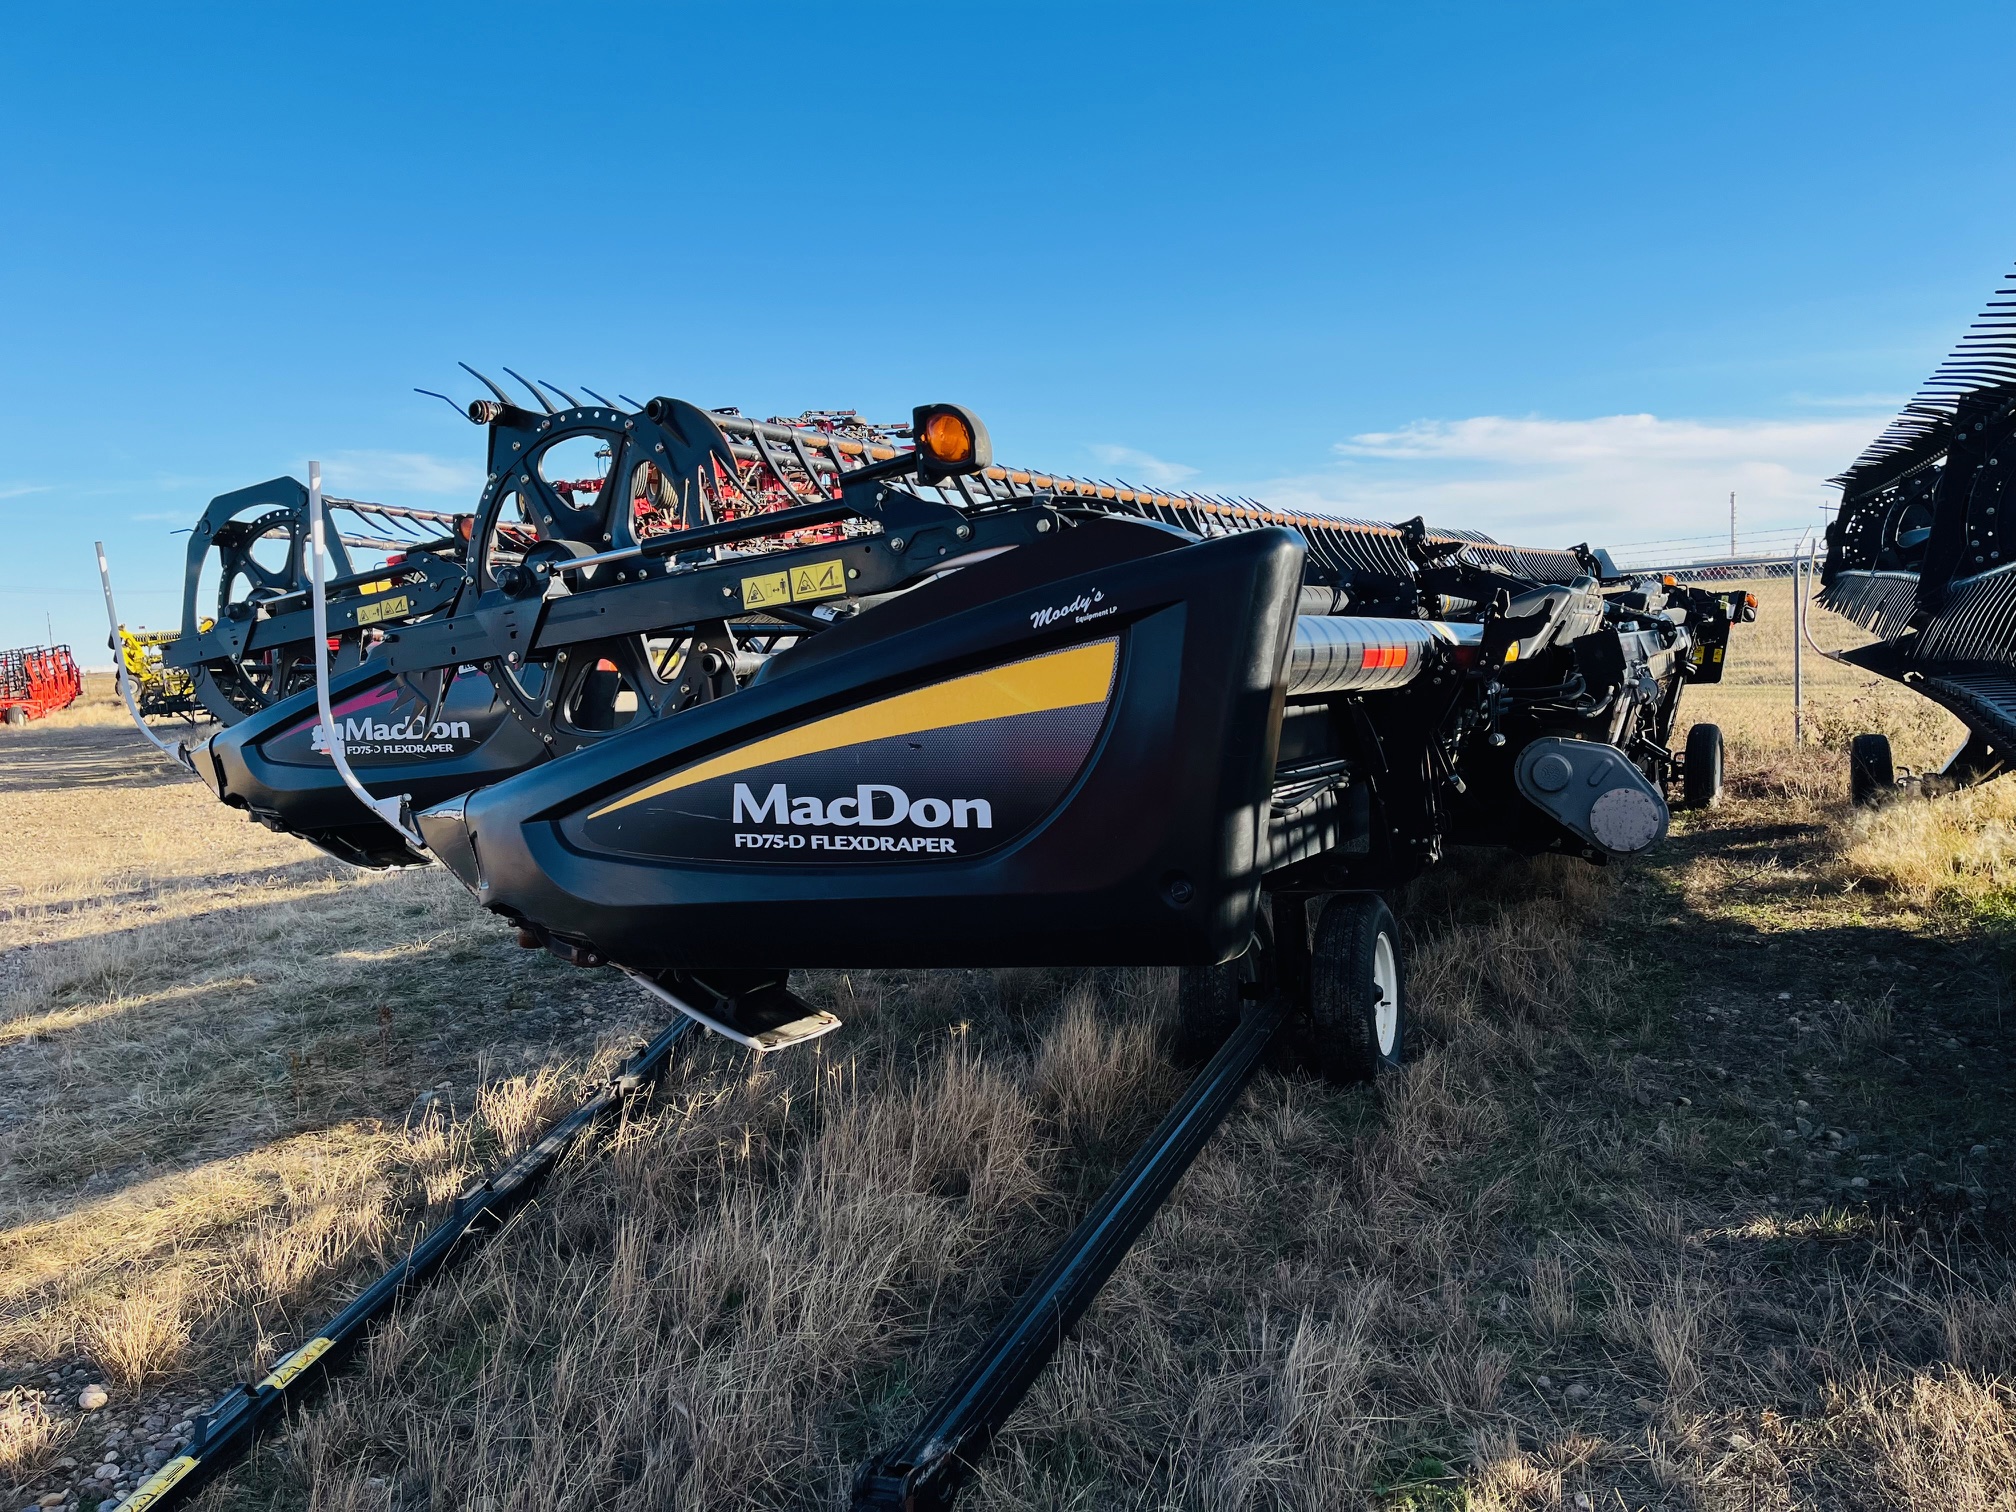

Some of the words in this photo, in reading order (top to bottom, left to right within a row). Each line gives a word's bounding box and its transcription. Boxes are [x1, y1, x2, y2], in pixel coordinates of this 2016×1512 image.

[1030, 587, 1104, 629] Moody's
[1075, 609, 1108, 623] Equipment
[1109, 606, 1118, 614] LP
[345, 716, 471, 741] MacDon
[383, 744, 454, 754] FLEXDRAPER
[732, 783, 992, 828] MacDon
[734, 833, 805, 849] FD75-D
[810, 835, 957, 854] FLEXDRAPER
